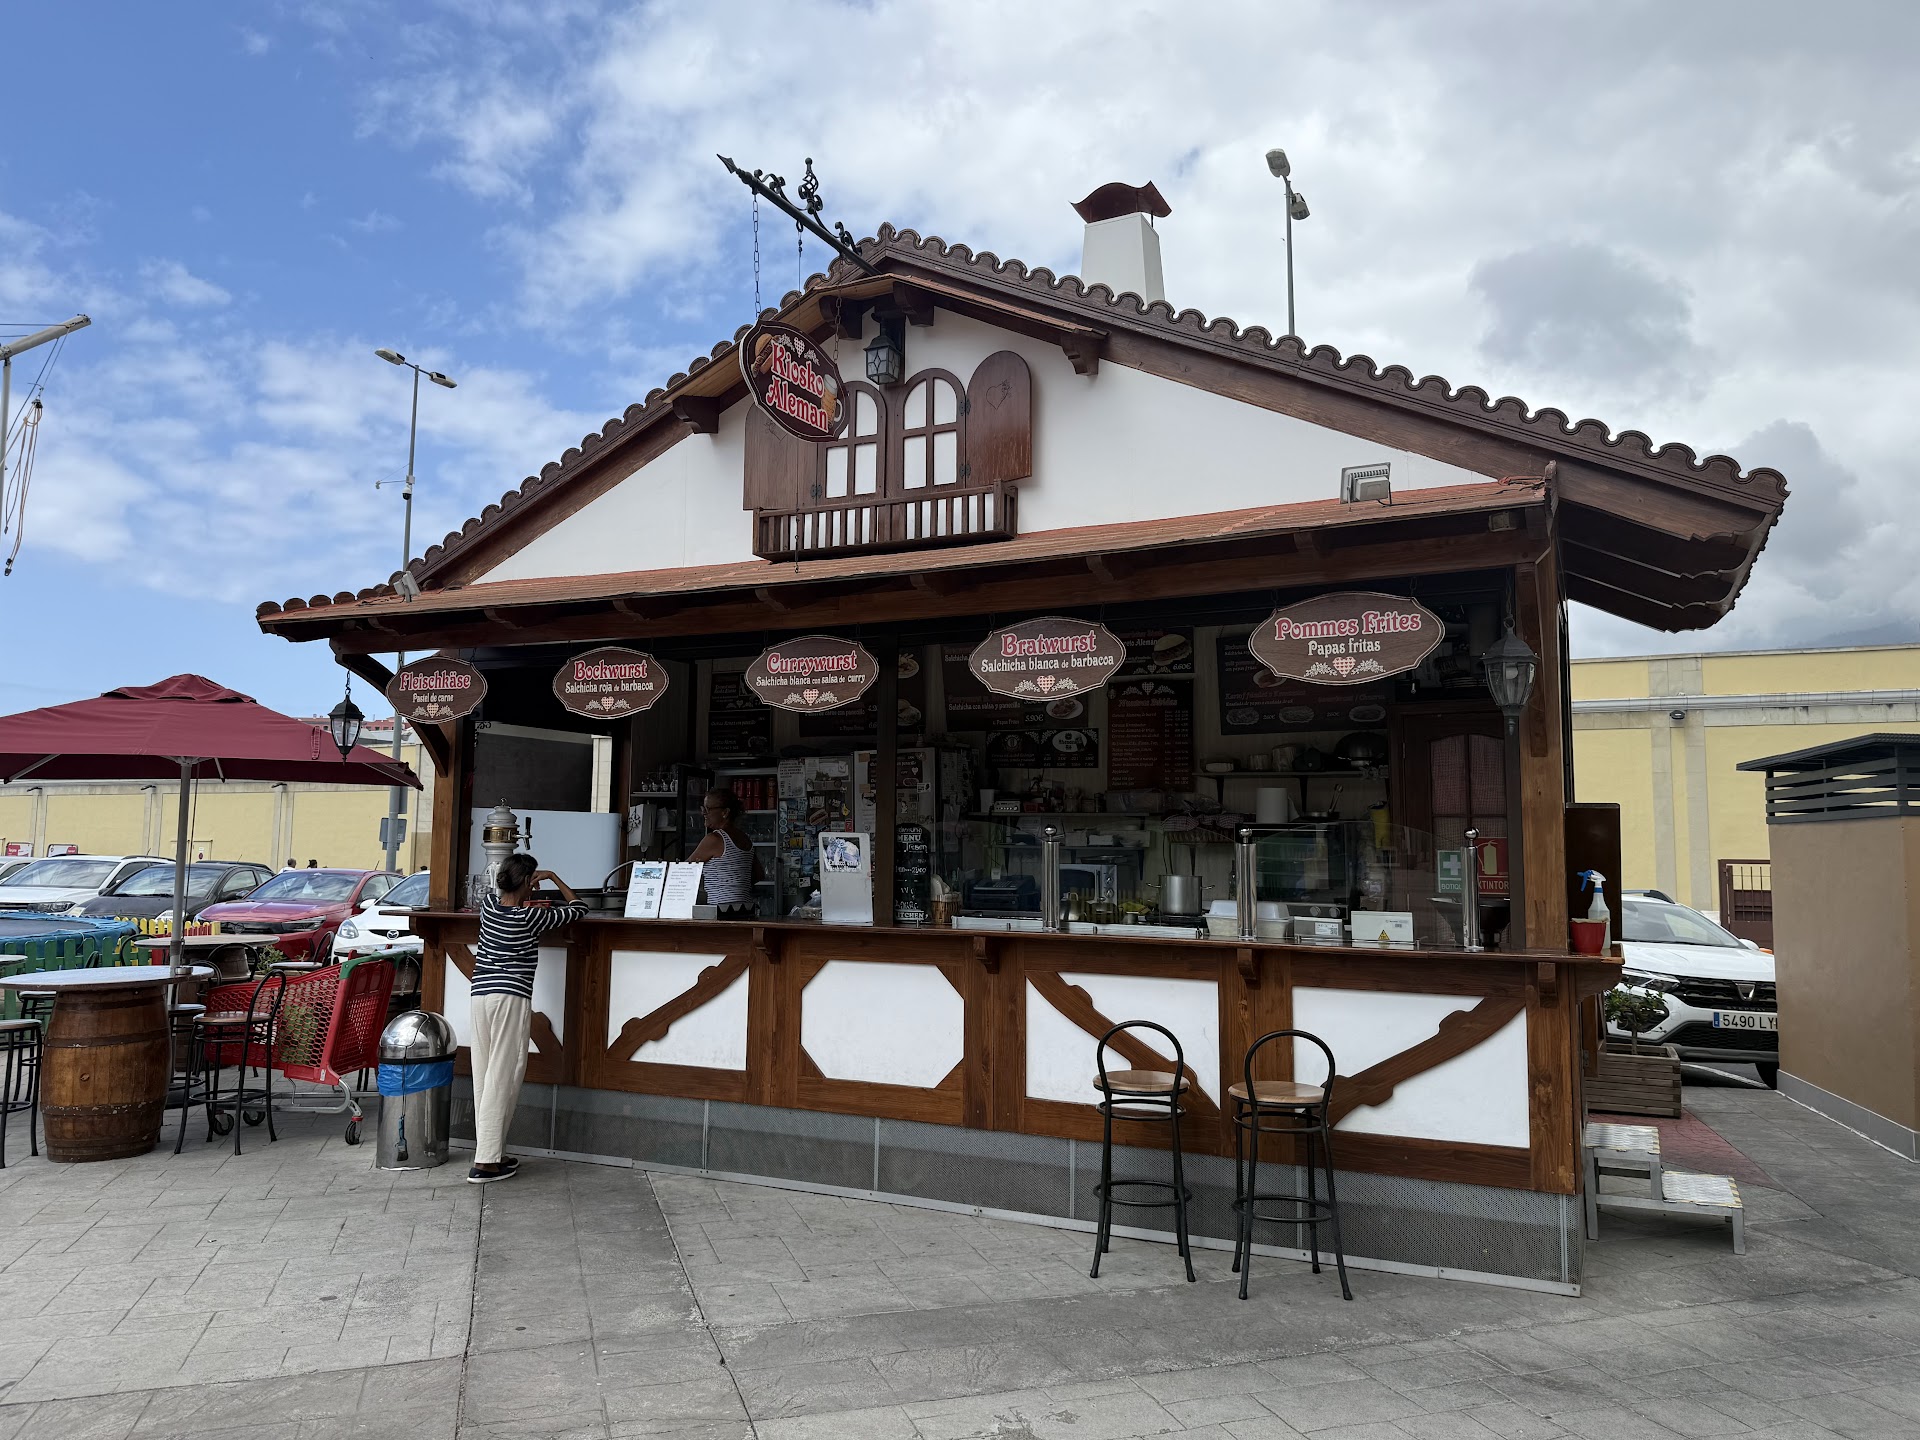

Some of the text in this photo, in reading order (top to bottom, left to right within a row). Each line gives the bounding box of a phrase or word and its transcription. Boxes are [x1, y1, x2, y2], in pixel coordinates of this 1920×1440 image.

[771, 341, 824, 398] Kiosko
[766, 376, 828, 432] Aleman
[1274, 610, 1421, 640] Pommes Frites
[1000, 630, 1096, 657] Bratwurst
[1308, 638, 1380, 658] Papas fritas
[574, 660, 648, 680] Bockwurst
[767, 650, 857, 676] Currywurst
[981, 656, 1026, 673] Salchicha
[1028, 654, 1060, 670] blanca
[1062, 660, 1068, 668] de
[1070, 654, 1114, 668] barbacoa
[399, 670, 471, 691] Fleischkäse
[565, 682, 597, 694] Salchicha
[599, 682, 612, 694] roja
[621, 680, 654, 692] barbacoa
[756, 676, 788, 686] Salchicha
[790, 675, 810, 686] blanca
[822, 674, 838, 684] salsa
[848, 674, 865, 684] curry
[412, 692, 429, 702] Pastel
[430, 692, 437, 702] de
[1478, 880, 1509, 889] XTINTOR
[1722, 1014, 1755, 1028] 5490
